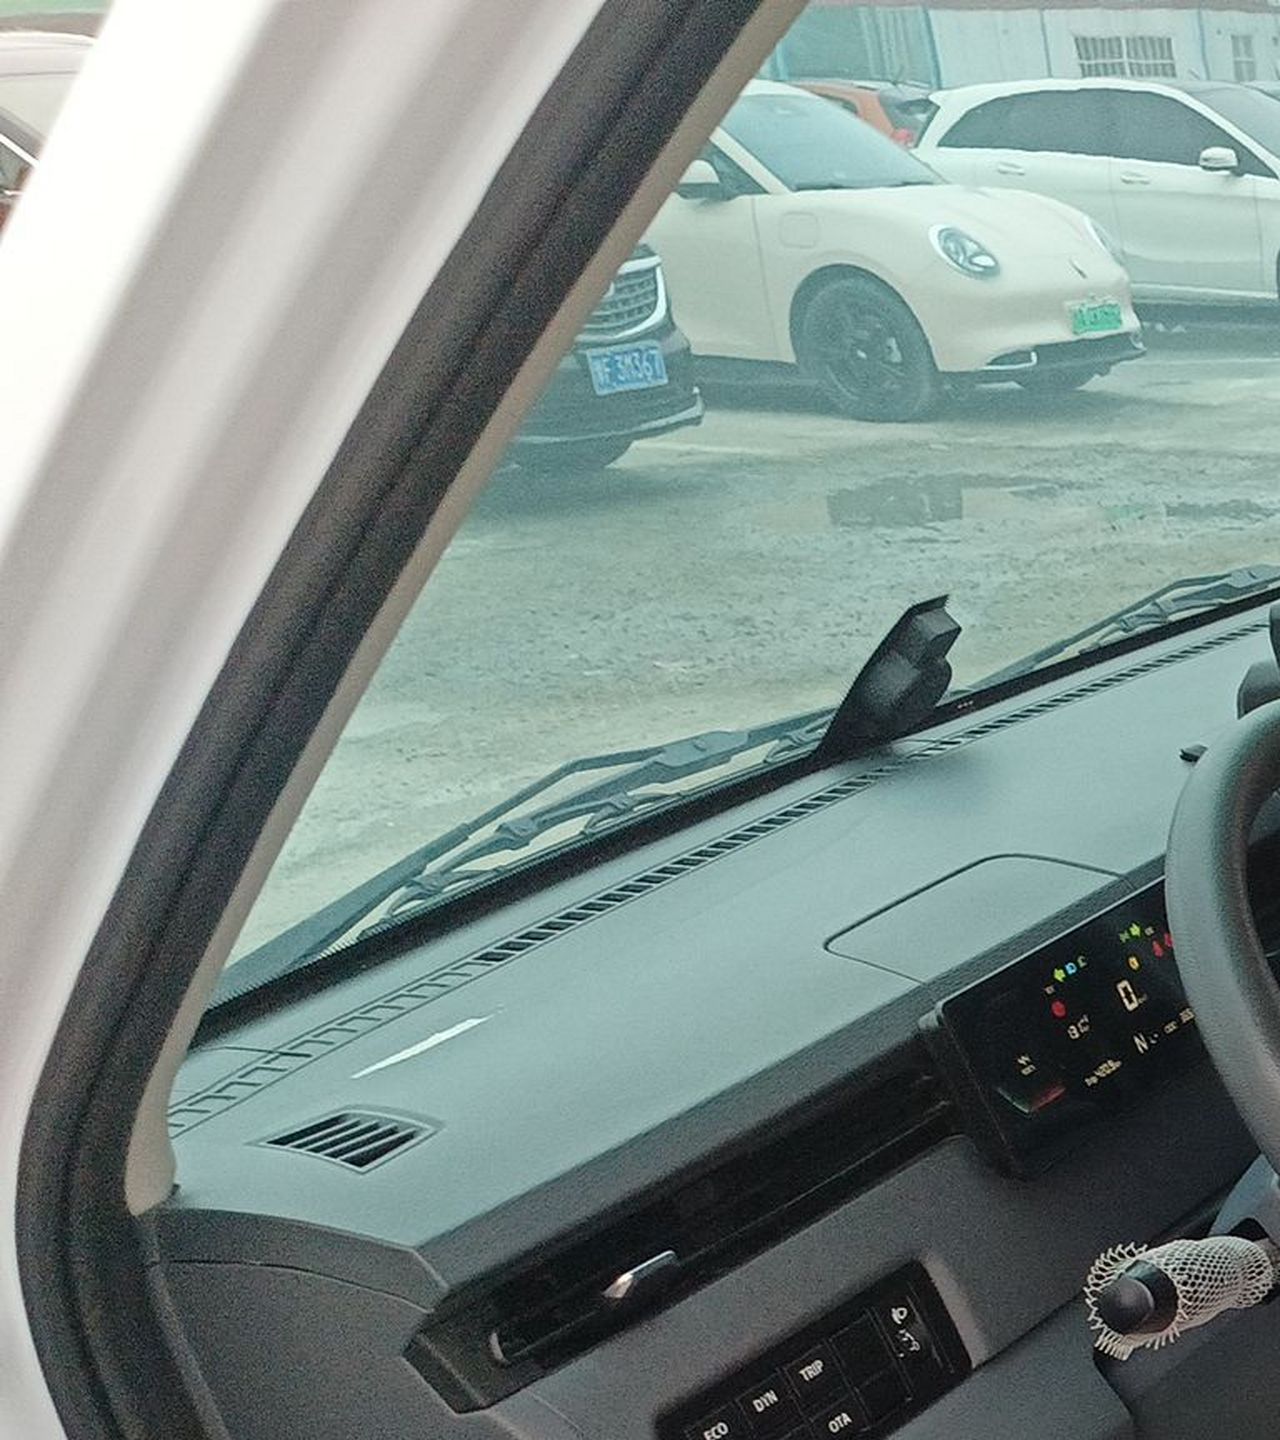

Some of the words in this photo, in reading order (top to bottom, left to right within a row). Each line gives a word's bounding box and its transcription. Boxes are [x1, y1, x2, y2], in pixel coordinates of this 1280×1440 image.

[799, 1359, 824, 1381] TRIP
[752, 1390, 779, 1412] DYN
[828, 1412, 853, 1433] OTA
